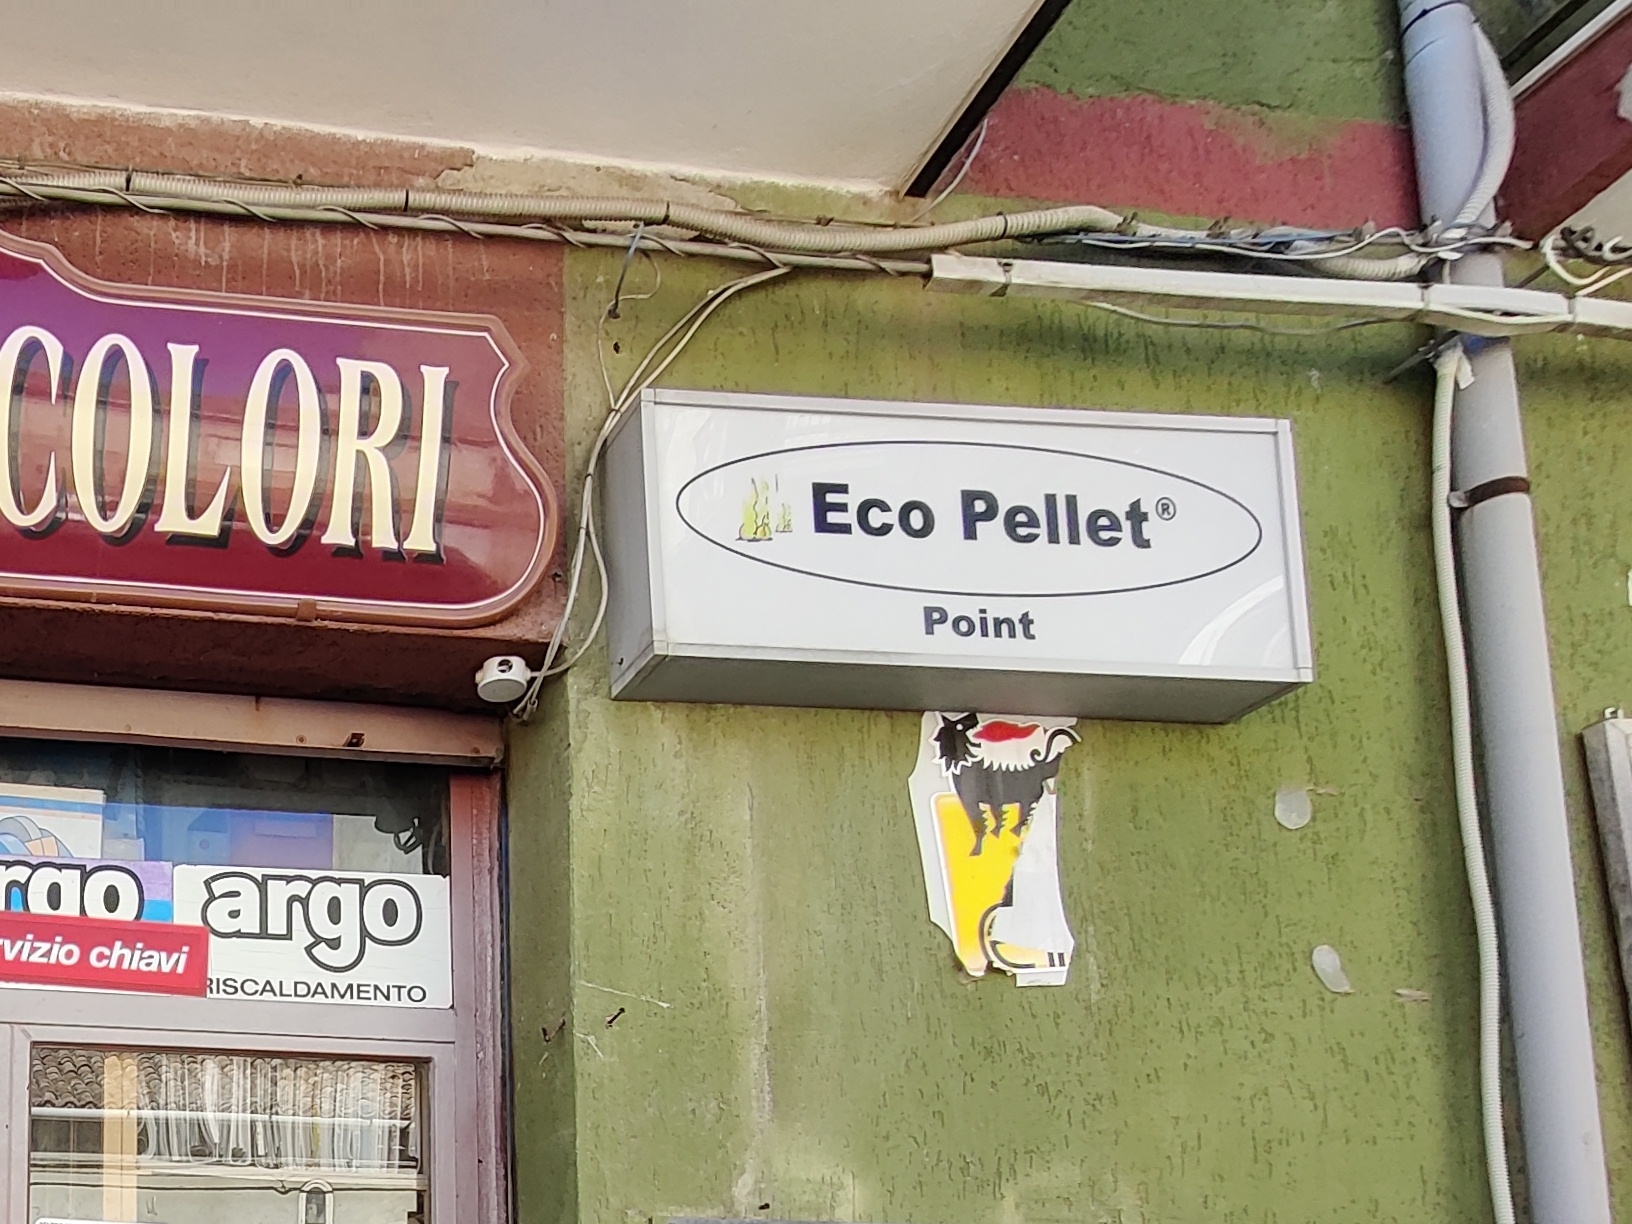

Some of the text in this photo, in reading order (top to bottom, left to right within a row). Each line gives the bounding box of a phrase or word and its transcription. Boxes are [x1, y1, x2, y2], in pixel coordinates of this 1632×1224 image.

[811, 481, 936, 539] Eco
[922, 605, 1037, 642] Point
[200, 870, 423, 973] argo
[89, 940, 190, 974] chiavi
